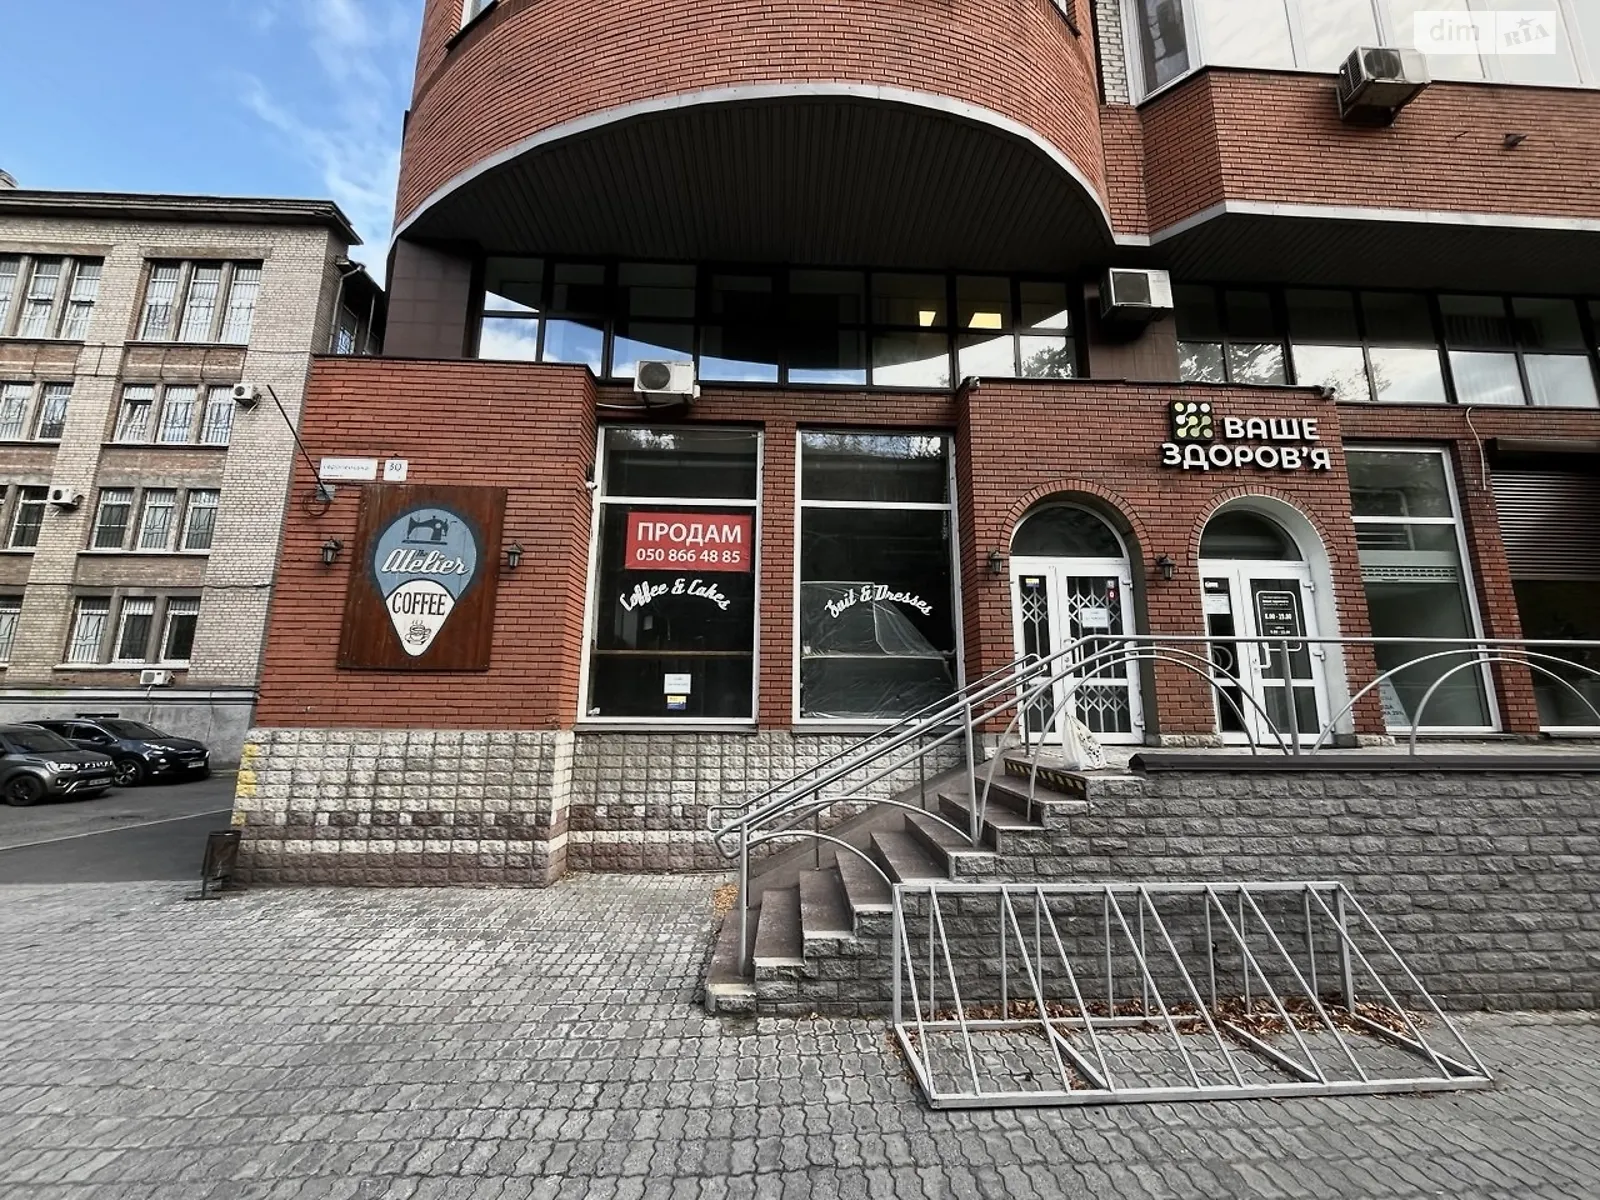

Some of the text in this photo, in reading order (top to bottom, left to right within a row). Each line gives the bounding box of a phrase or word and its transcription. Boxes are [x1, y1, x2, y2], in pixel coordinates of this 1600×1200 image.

[1223, 417, 1320, 440] ВАШЕ
[636, 521, 742, 546] ПРОДАМ
[381, 548, 469, 576] Atelier
[636, 548, 741, 563] 050 866 48 85
[392, 592, 447, 616] COFFEE
[619, 583, 669, 612] Coffee
[687, 578, 731, 611] Cakes
[873, 584, 934, 617] Dresses
